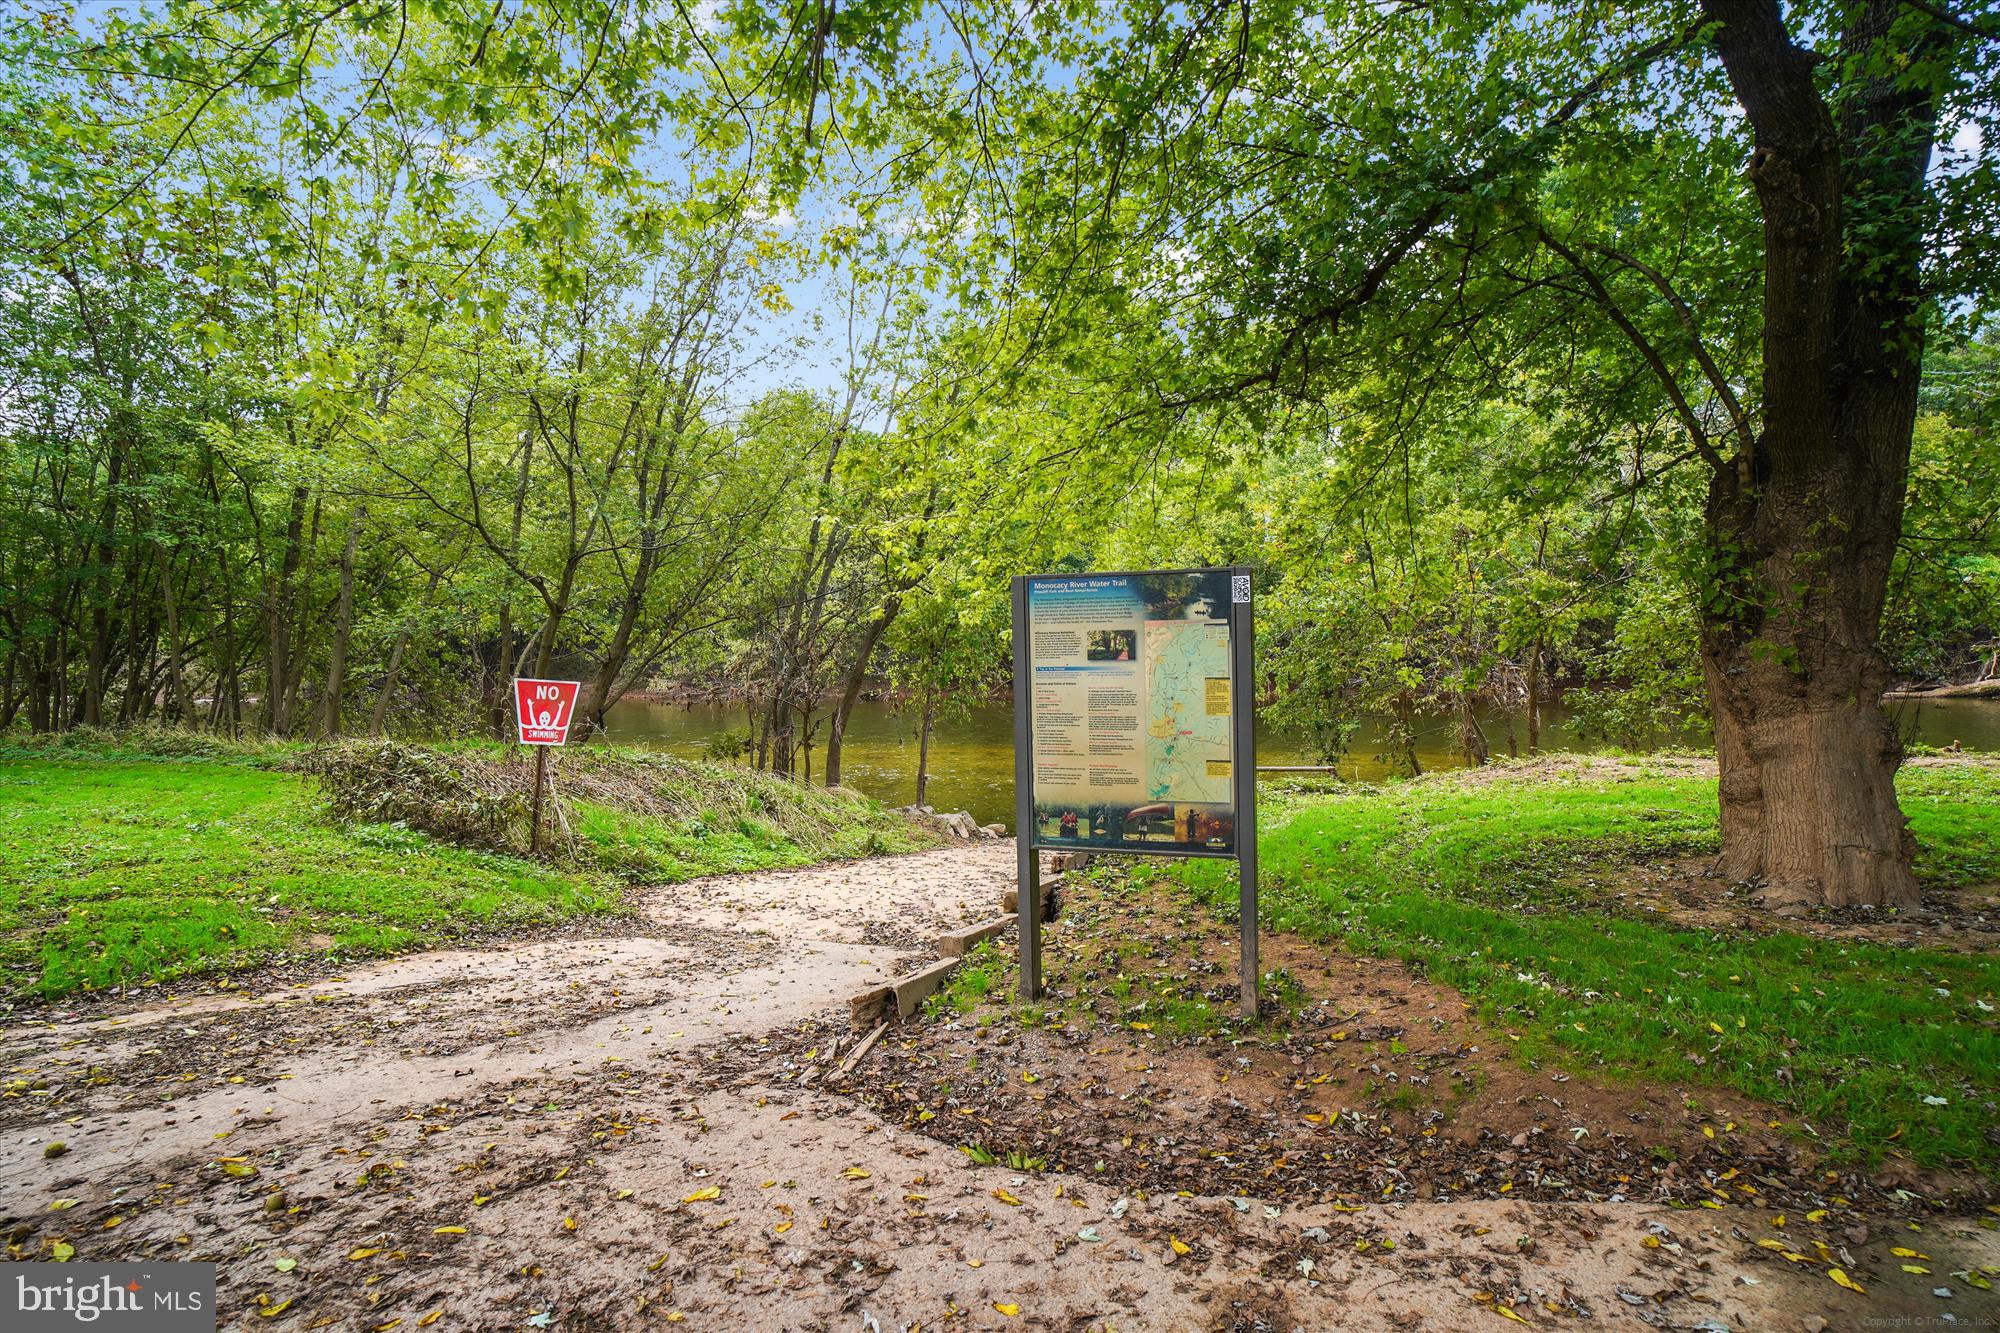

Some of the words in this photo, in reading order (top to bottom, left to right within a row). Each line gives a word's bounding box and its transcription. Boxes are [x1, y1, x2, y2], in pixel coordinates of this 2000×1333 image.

[1034, 582, 1069, 591] Monocacy
[1070, 581, 1087, 589] River
[1089, 580, 1111, 588] Water
[1112, 579, 1127, 587] Trail
[536, 685, 560, 701] NO
[528, 730, 559, 739] SWIMMING
